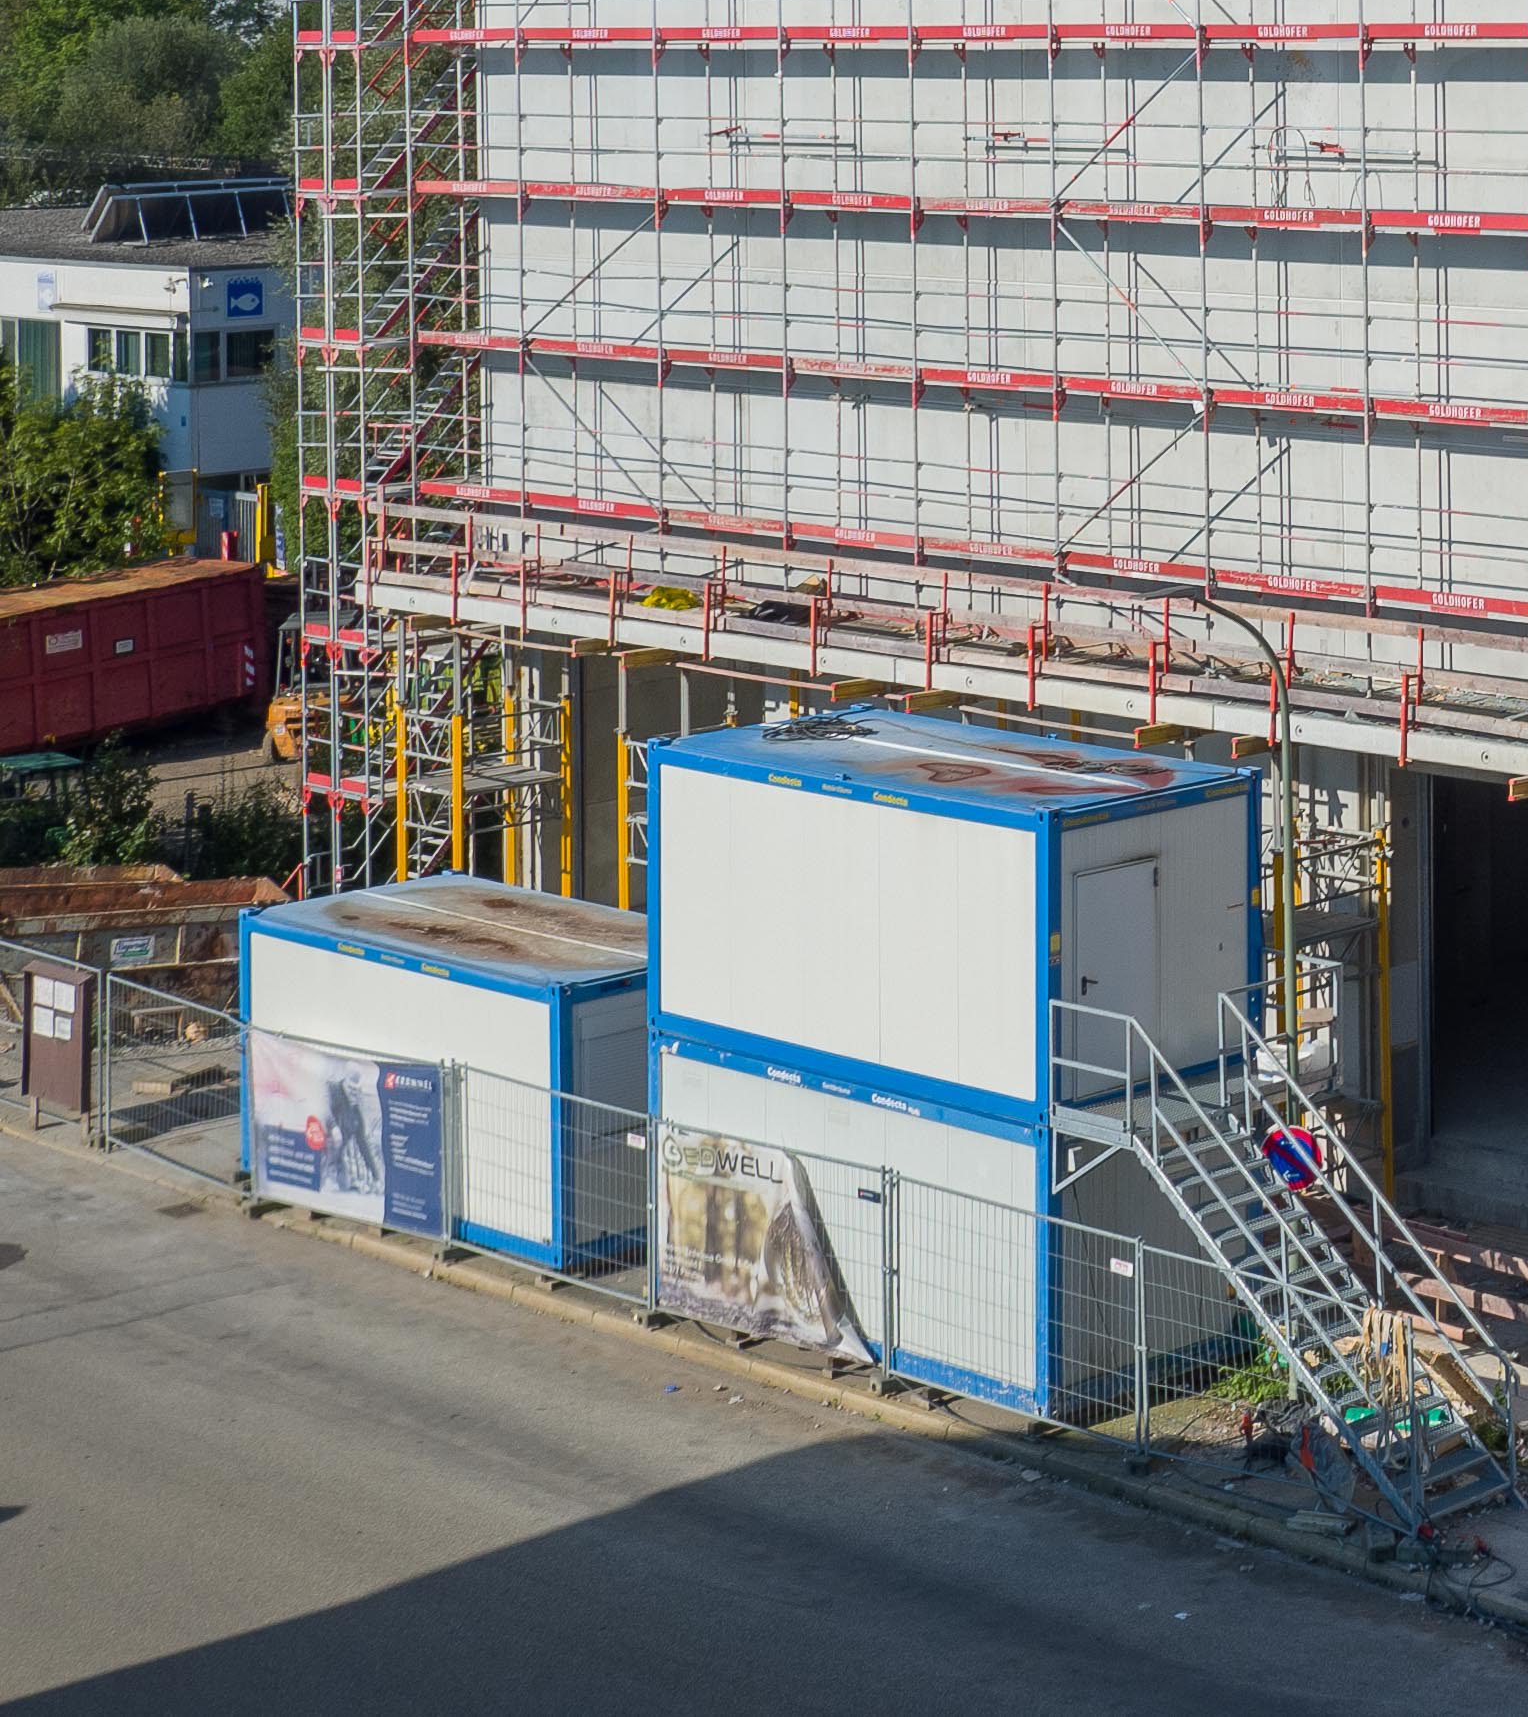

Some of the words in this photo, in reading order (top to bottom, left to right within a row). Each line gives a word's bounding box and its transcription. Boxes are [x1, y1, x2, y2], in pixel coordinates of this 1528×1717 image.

[1260, 27, 1311, 38] GOLDHOFER
[1426, 26, 1478, 38] GOLDHOFER
[1429, 215, 1481, 227] GOLDHOFER
[1430, 404, 1482, 418] GOLDHOFER
[1267, 575, 1317, 592] GOLDHOFER
[1431, 594, 1485, 610] GOLDHOFER
